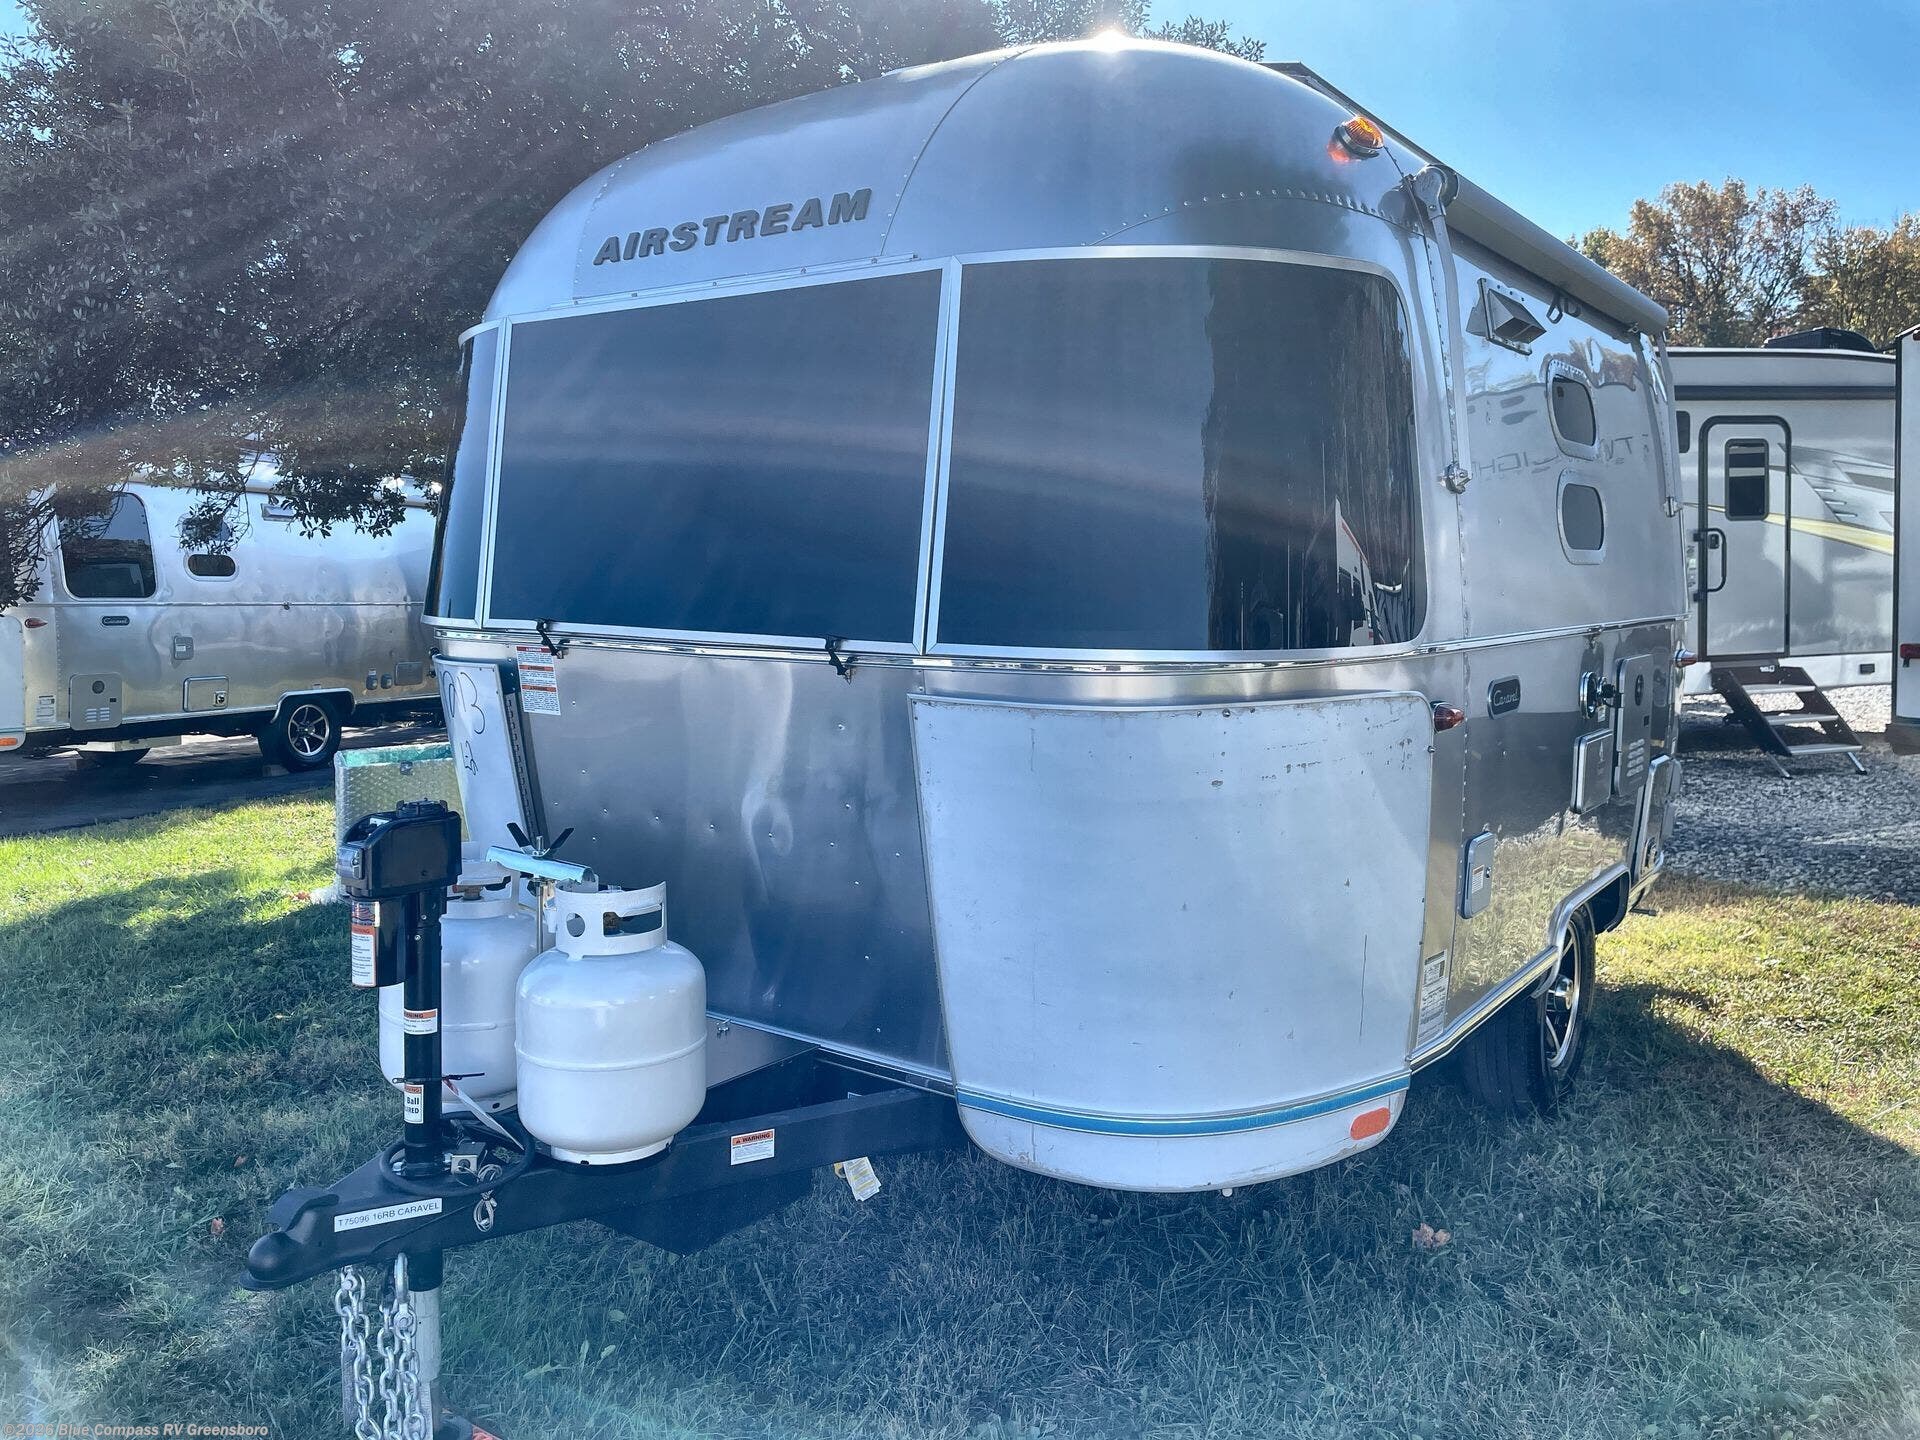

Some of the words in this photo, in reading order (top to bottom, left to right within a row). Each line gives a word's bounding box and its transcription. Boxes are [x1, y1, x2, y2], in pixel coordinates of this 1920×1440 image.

[593, 188, 872, 265] AIRSTREAM
[742, 1132, 771, 1143] WARNING
[373, 1210, 396, 1221] 16RB
[397, 1202, 440, 1216] CARAVEL
